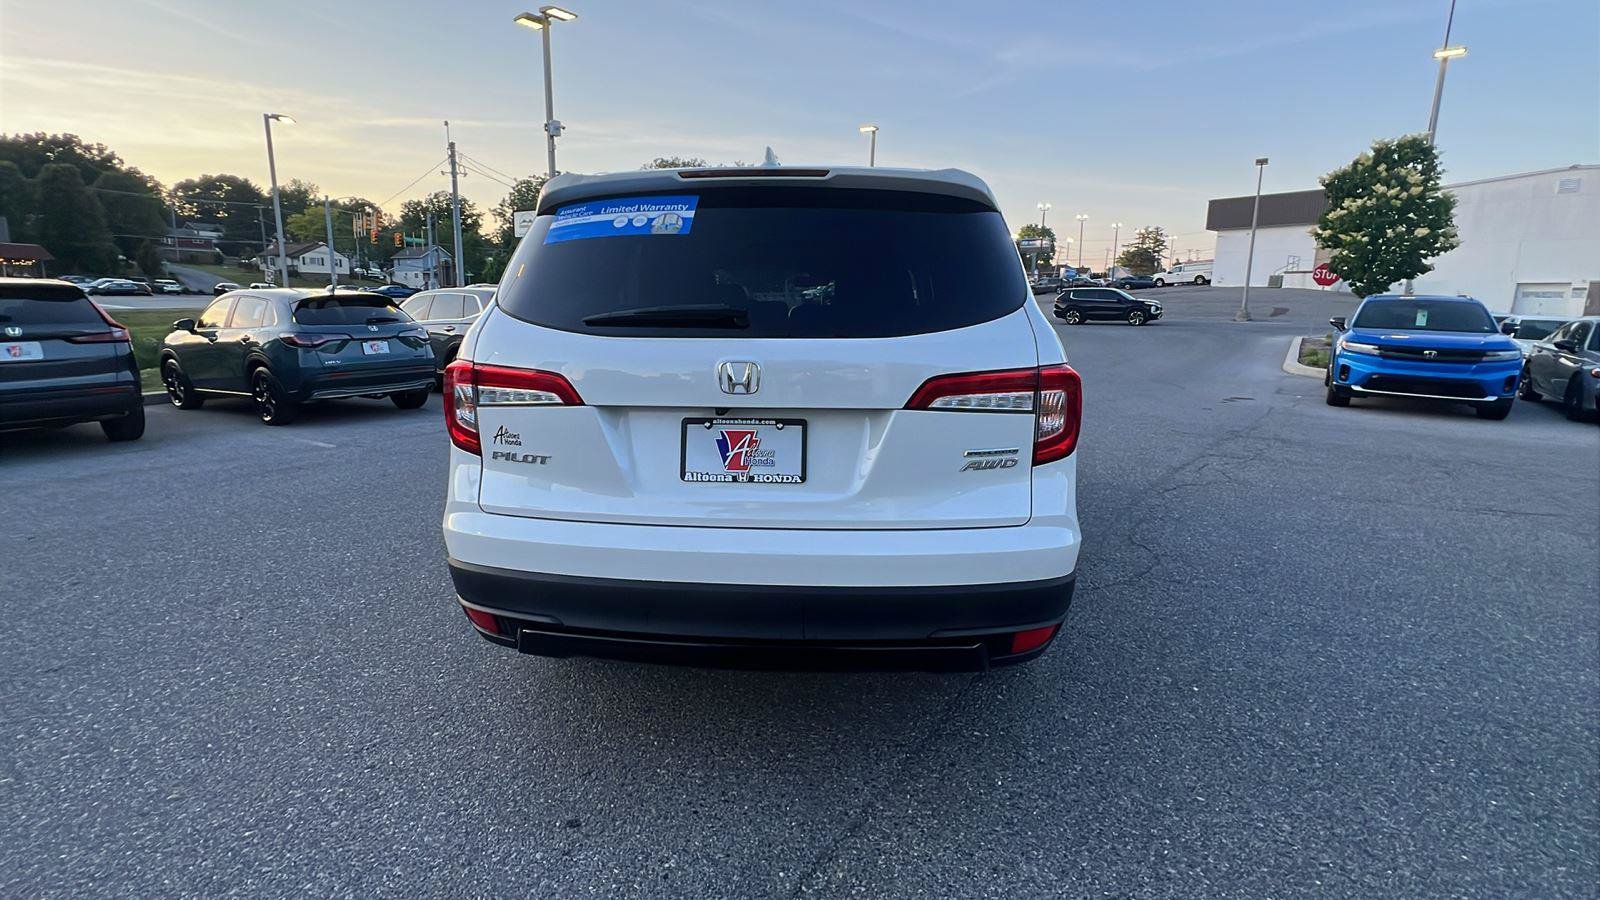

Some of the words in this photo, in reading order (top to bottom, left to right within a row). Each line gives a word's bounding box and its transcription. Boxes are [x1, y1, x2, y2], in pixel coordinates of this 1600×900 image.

[600, 204, 639, 214] Limited
[639, 203, 689, 212] Warranty
[491, 451, 552, 465] PILOT
[744, 456, 775, 466] Honda
[959, 458, 1018, 472] AWD
[684, 472, 733, 482] Altoona
[753, 474, 802, 483] HONDA
